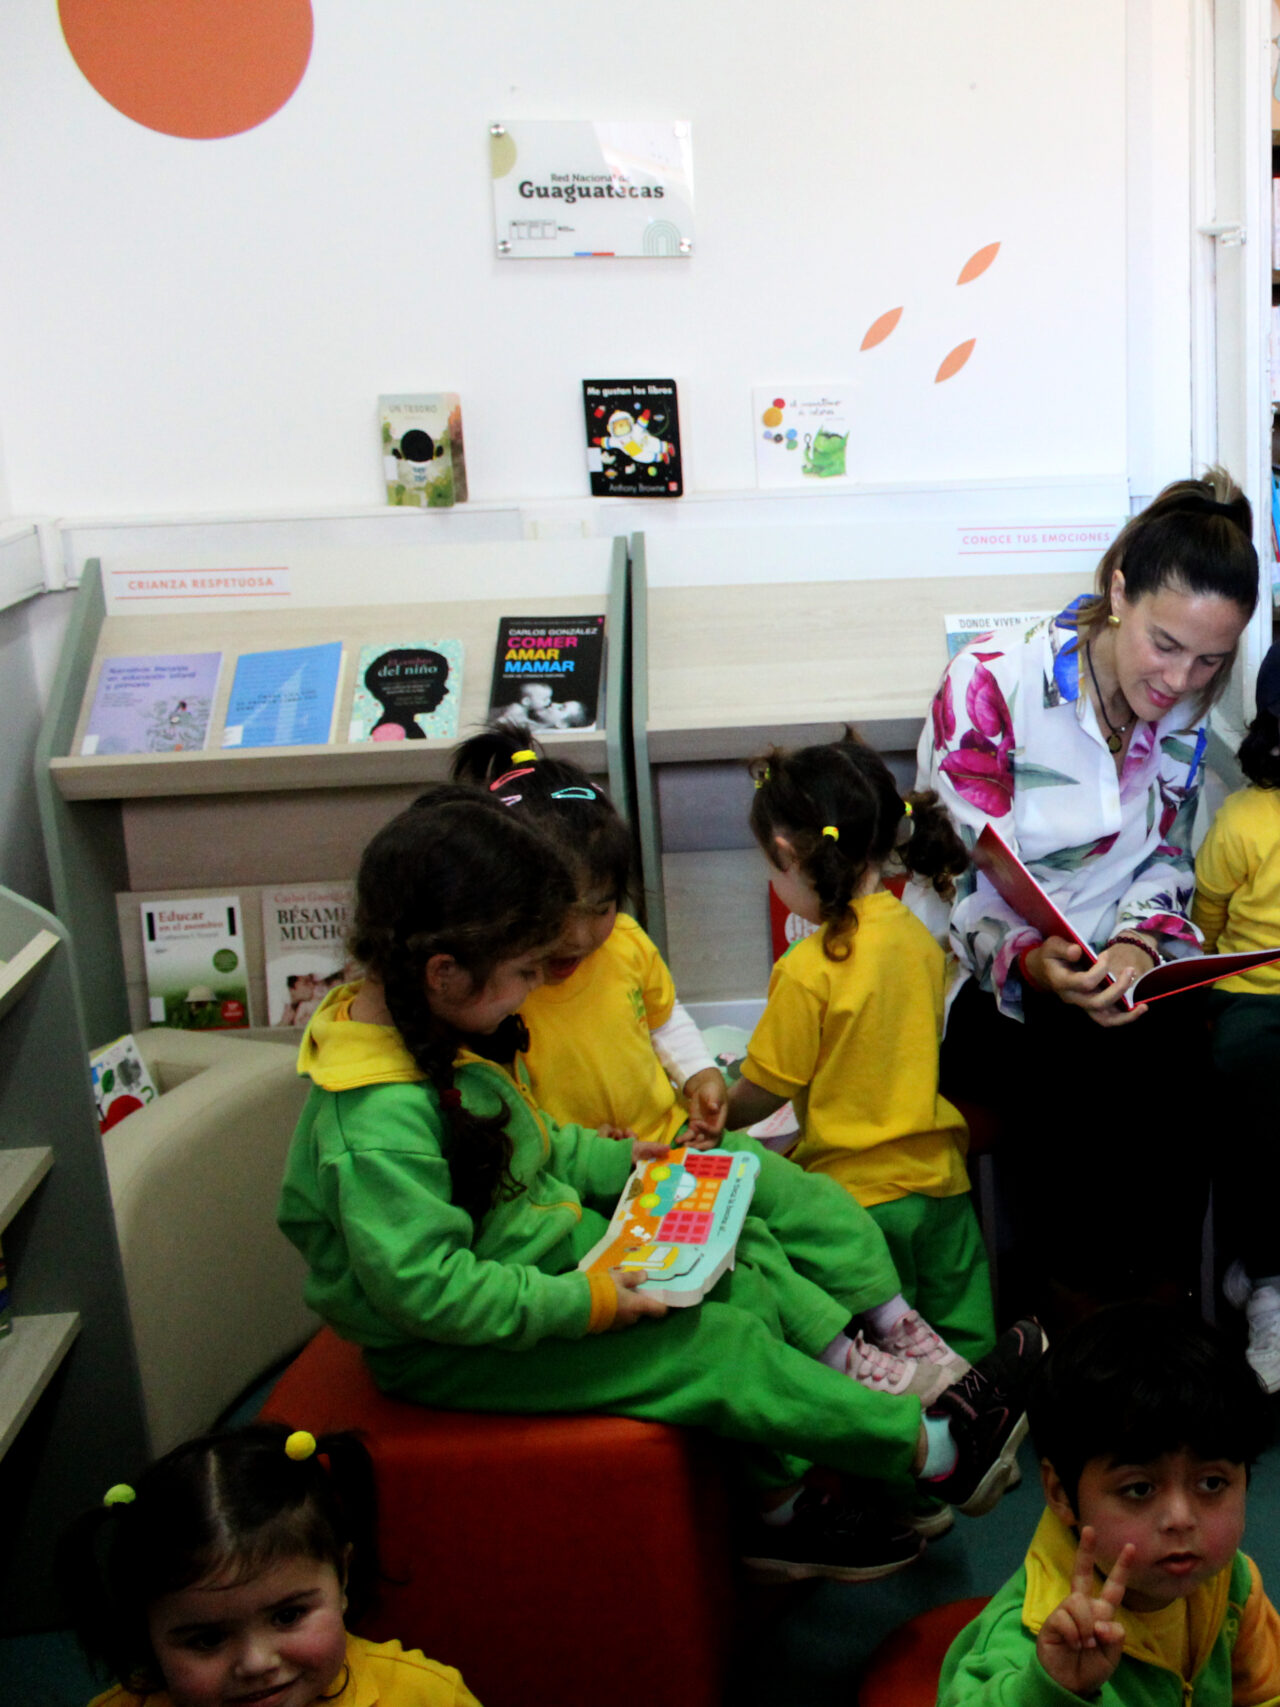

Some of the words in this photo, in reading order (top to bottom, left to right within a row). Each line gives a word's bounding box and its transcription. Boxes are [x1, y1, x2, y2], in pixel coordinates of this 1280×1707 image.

[550, 173, 570, 183] Red
[519, 180, 664, 204] Guaguatecas
[586, 386, 601, 397] Me
[602, 387, 632, 398] gustan
[633, 386, 647, 396] los
[648, 385, 674, 396] libros
[609, 483, 637, 495] Anthony
[638, 483, 666, 493] Browne
[962, 535, 1012, 545] CONOCE
[1017, 534, 1038, 544] TUS
[1042, 532, 1111, 543] EMOCIONES
[128, 579, 188, 591] CRIANZA
[191, 577, 275, 589] RESPETUOSA
[958, 618, 991, 629] DONDE
[994, 617, 1022, 627] VIVEN
[508, 628, 547, 636] CARLOS
[547, 627, 599, 636] GONZÁLEZ
[507, 636, 579, 649] COMER
[504, 648, 560, 661] AMAR
[377, 664, 401, 677] del
[404, 663, 439, 675] niño
[504, 660, 576, 673] MAMAR
[158, 910, 204, 922] Educar
[173, 923, 182, 931] el
